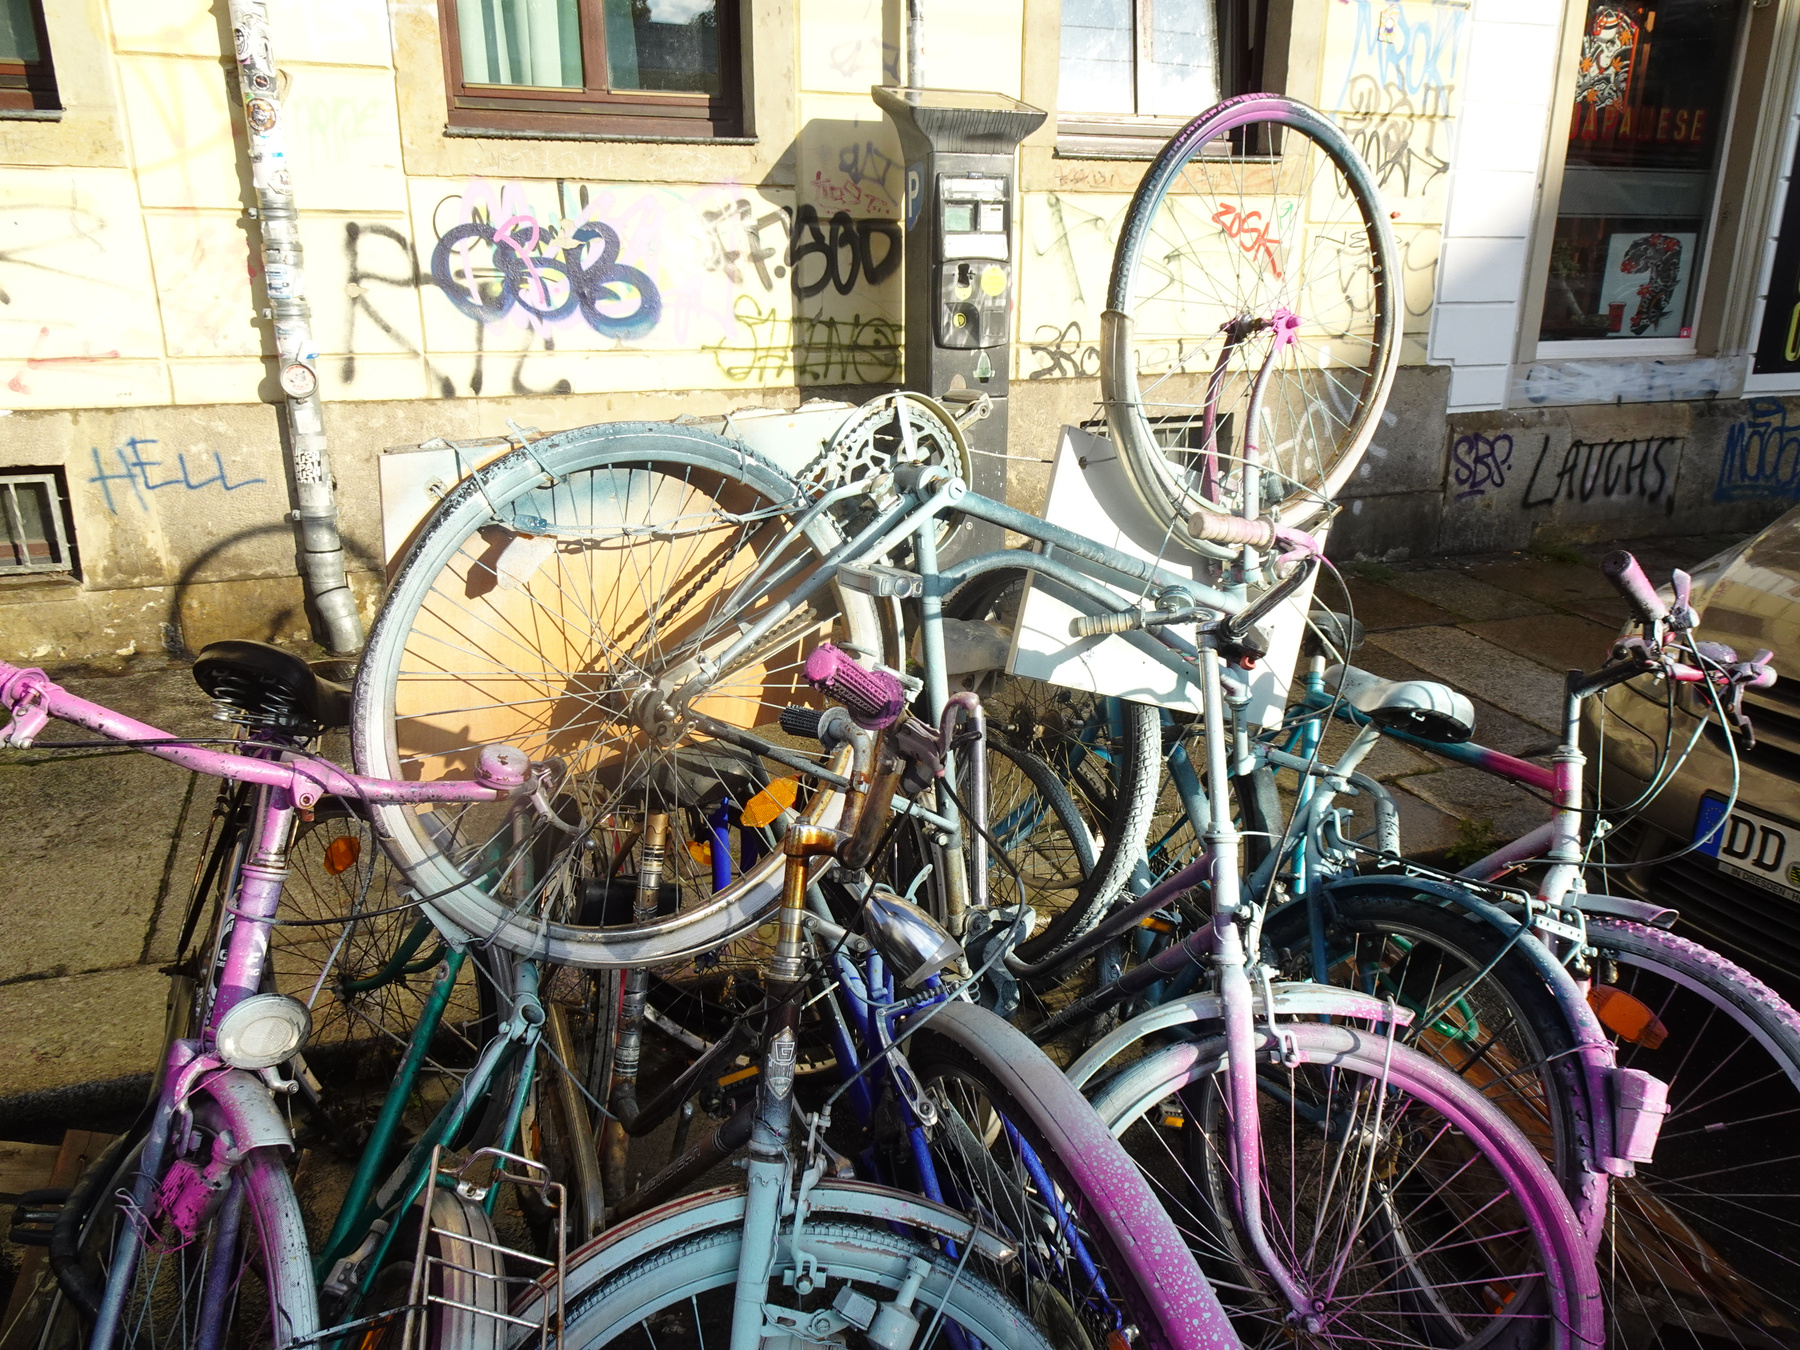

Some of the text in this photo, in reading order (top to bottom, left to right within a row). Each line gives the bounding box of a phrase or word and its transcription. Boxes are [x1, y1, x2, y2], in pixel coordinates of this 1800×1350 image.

[908, 170, 920, 218] P
[89, 437, 266, 515] HELL
[1722, 814, 1786, 872] DD
[1742, 872, 1787, 896] DRESDEN
